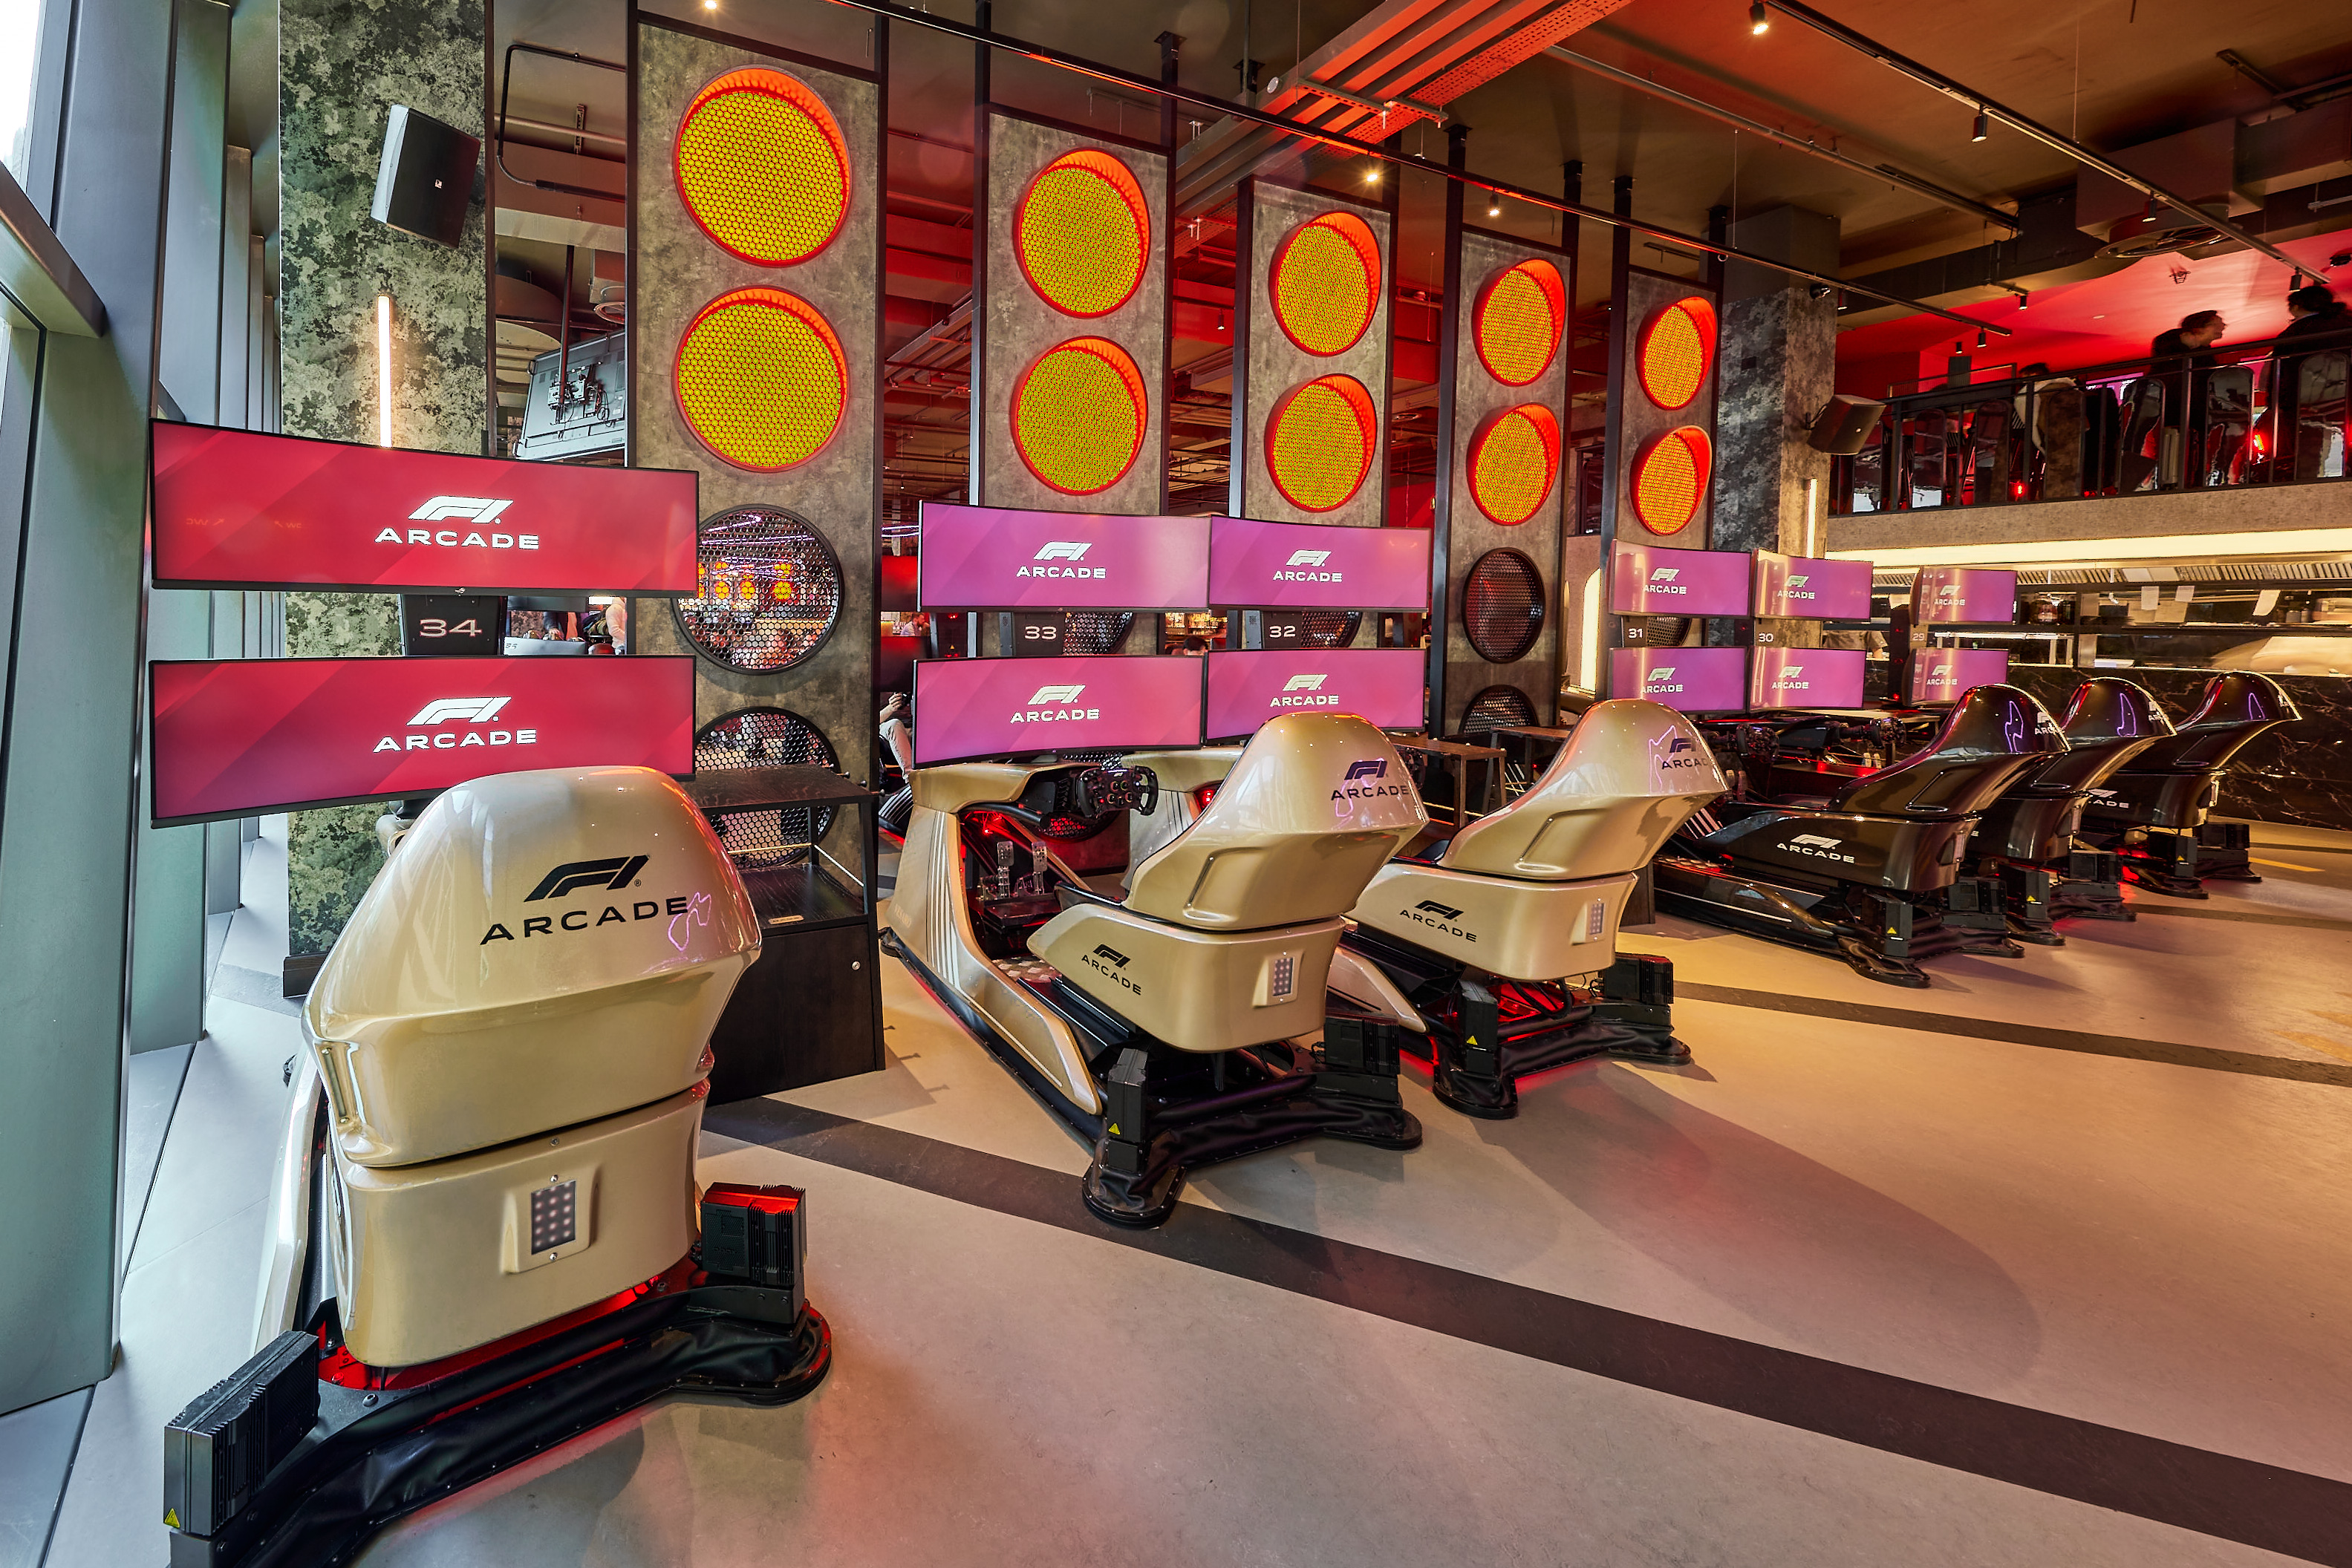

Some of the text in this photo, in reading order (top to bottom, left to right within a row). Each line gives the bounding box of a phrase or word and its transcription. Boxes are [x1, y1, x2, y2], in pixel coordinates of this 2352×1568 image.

[374, 527, 540, 550] ARCADE
[1016, 566, 1107, 579] ARCADE
[1273, 570, 1343, 583] ARCADE
[1642, 584, 1687, 595] ARCADE
[1777, 590, 1815, 600] ARCADE
[420, 618, 482, 637] 34
[1024, 626, 1057, 641] 33
[1268, 625, 1297, 638] 32
[1628, 628, 1644, 638] 31
[1758, 633, 1775, 642] 30
[1912, 633, 1925, 641] 29
[1640, 684, 1684, 693] ARCADE
[1771, 682, 1809, 690] ARCADE
[1269, 695, 1340, 708] ARCADE
[1010, 708, 1100, 724] ARCADE
[373, 729, 537, 753] ARCADE
[1661, 757, 1709, 770] ARCAD
[1330, 784, 1410, 801] ARCADE
[1776, 842, 1855, 864] ARCADE
[480, 895, 688, 945] ARCADE
[1399, 909, 1477, 943] ARCADE
[1081, 954, 1142, 996] ARCADE
